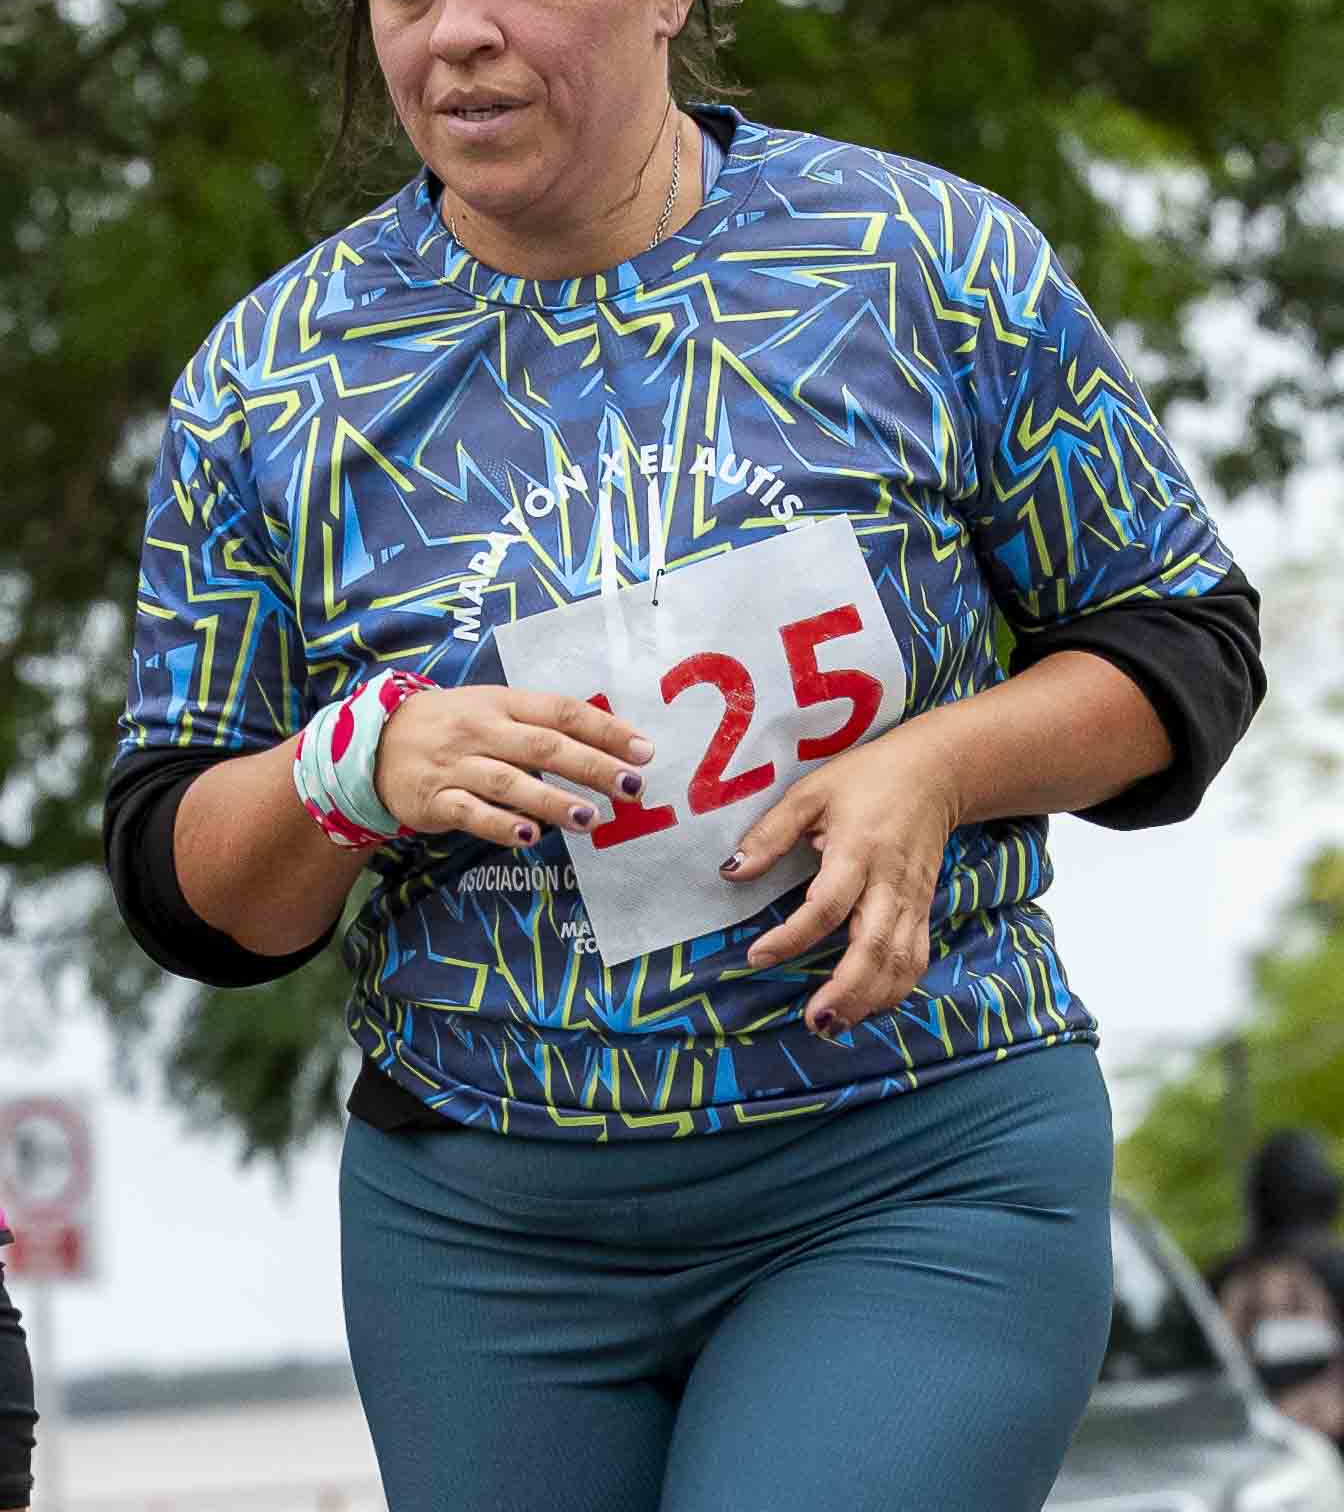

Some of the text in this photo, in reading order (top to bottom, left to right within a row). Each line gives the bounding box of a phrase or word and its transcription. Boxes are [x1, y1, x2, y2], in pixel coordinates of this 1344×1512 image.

[453, 444, 816, 642] MARATÓN X EL AUTIS
